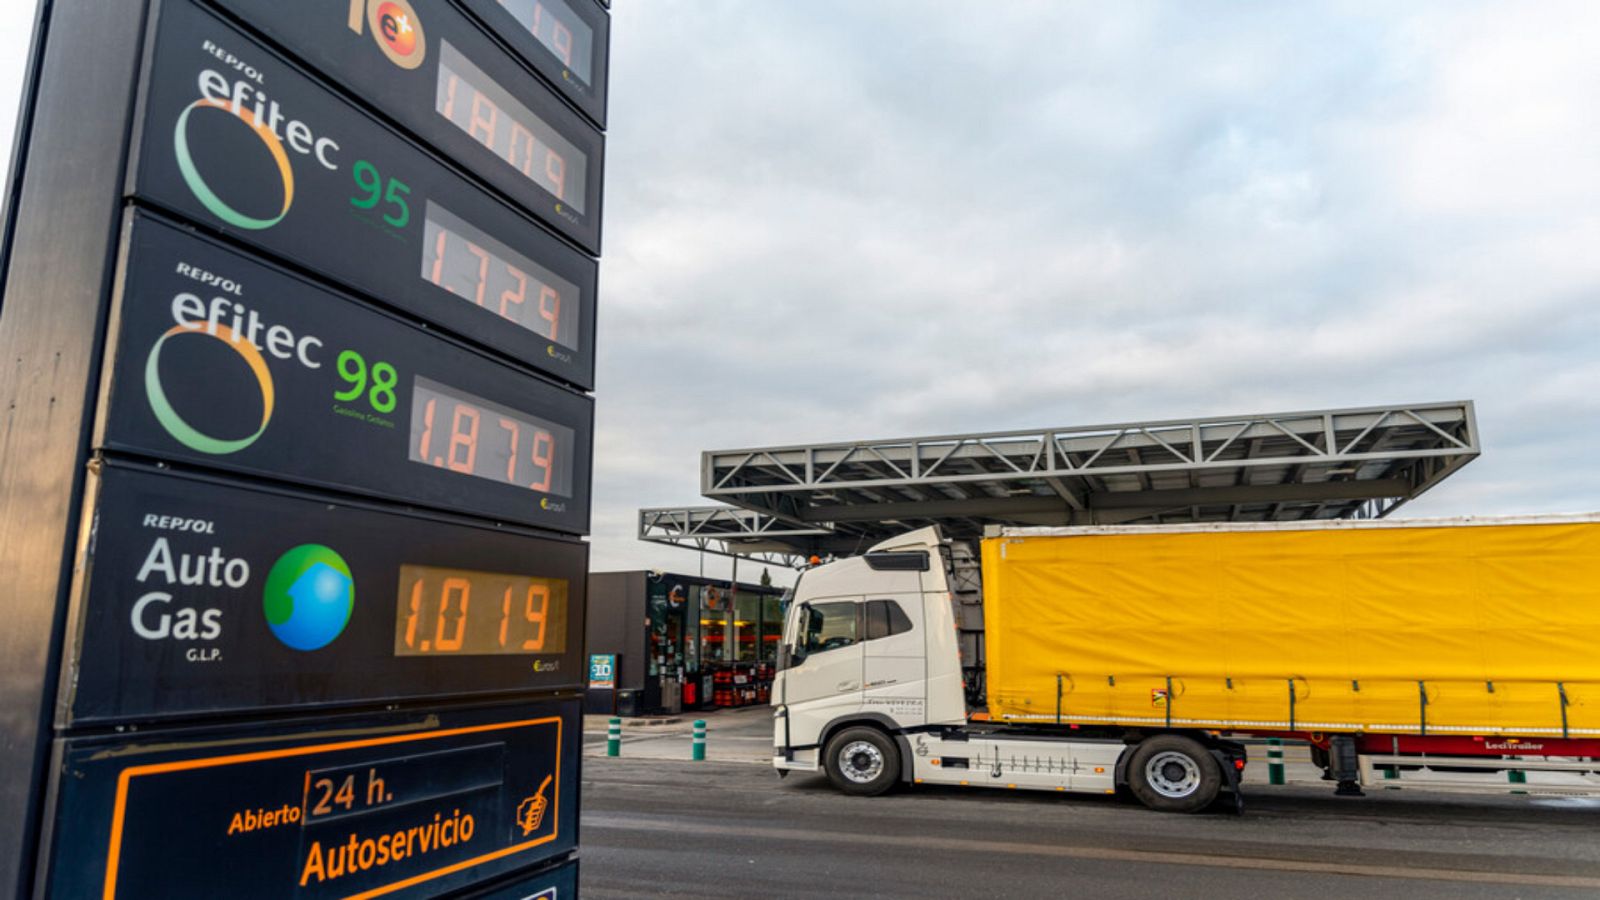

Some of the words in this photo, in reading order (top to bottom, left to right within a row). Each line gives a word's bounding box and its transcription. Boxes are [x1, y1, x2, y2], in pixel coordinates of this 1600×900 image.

[202, 39, 265, 84] REPSOL
[198, 68, 340, 170] efitec
[350, 159, 411, 228] 95
[176, 261, 243, 296] REPSOL
[171, 292, 323, 369] efitec
[334, 350, 398, 413] 98
[419, 398, 555, 493] 1.879
[142, 513, 215, 534] REPSOL
[136, 536, 250, 589] Auto
[130, 591, 223, 640] Gas
[404, 577, 551, 652] 1.019
[186, 648, 223, 662] G.L.P.
[227, 803, 300, 836] Abierto
[312, 774, 356, 817] 24
[366, 768, 393, 806] h.
[299, 808, 475, 887] Autoservicio
